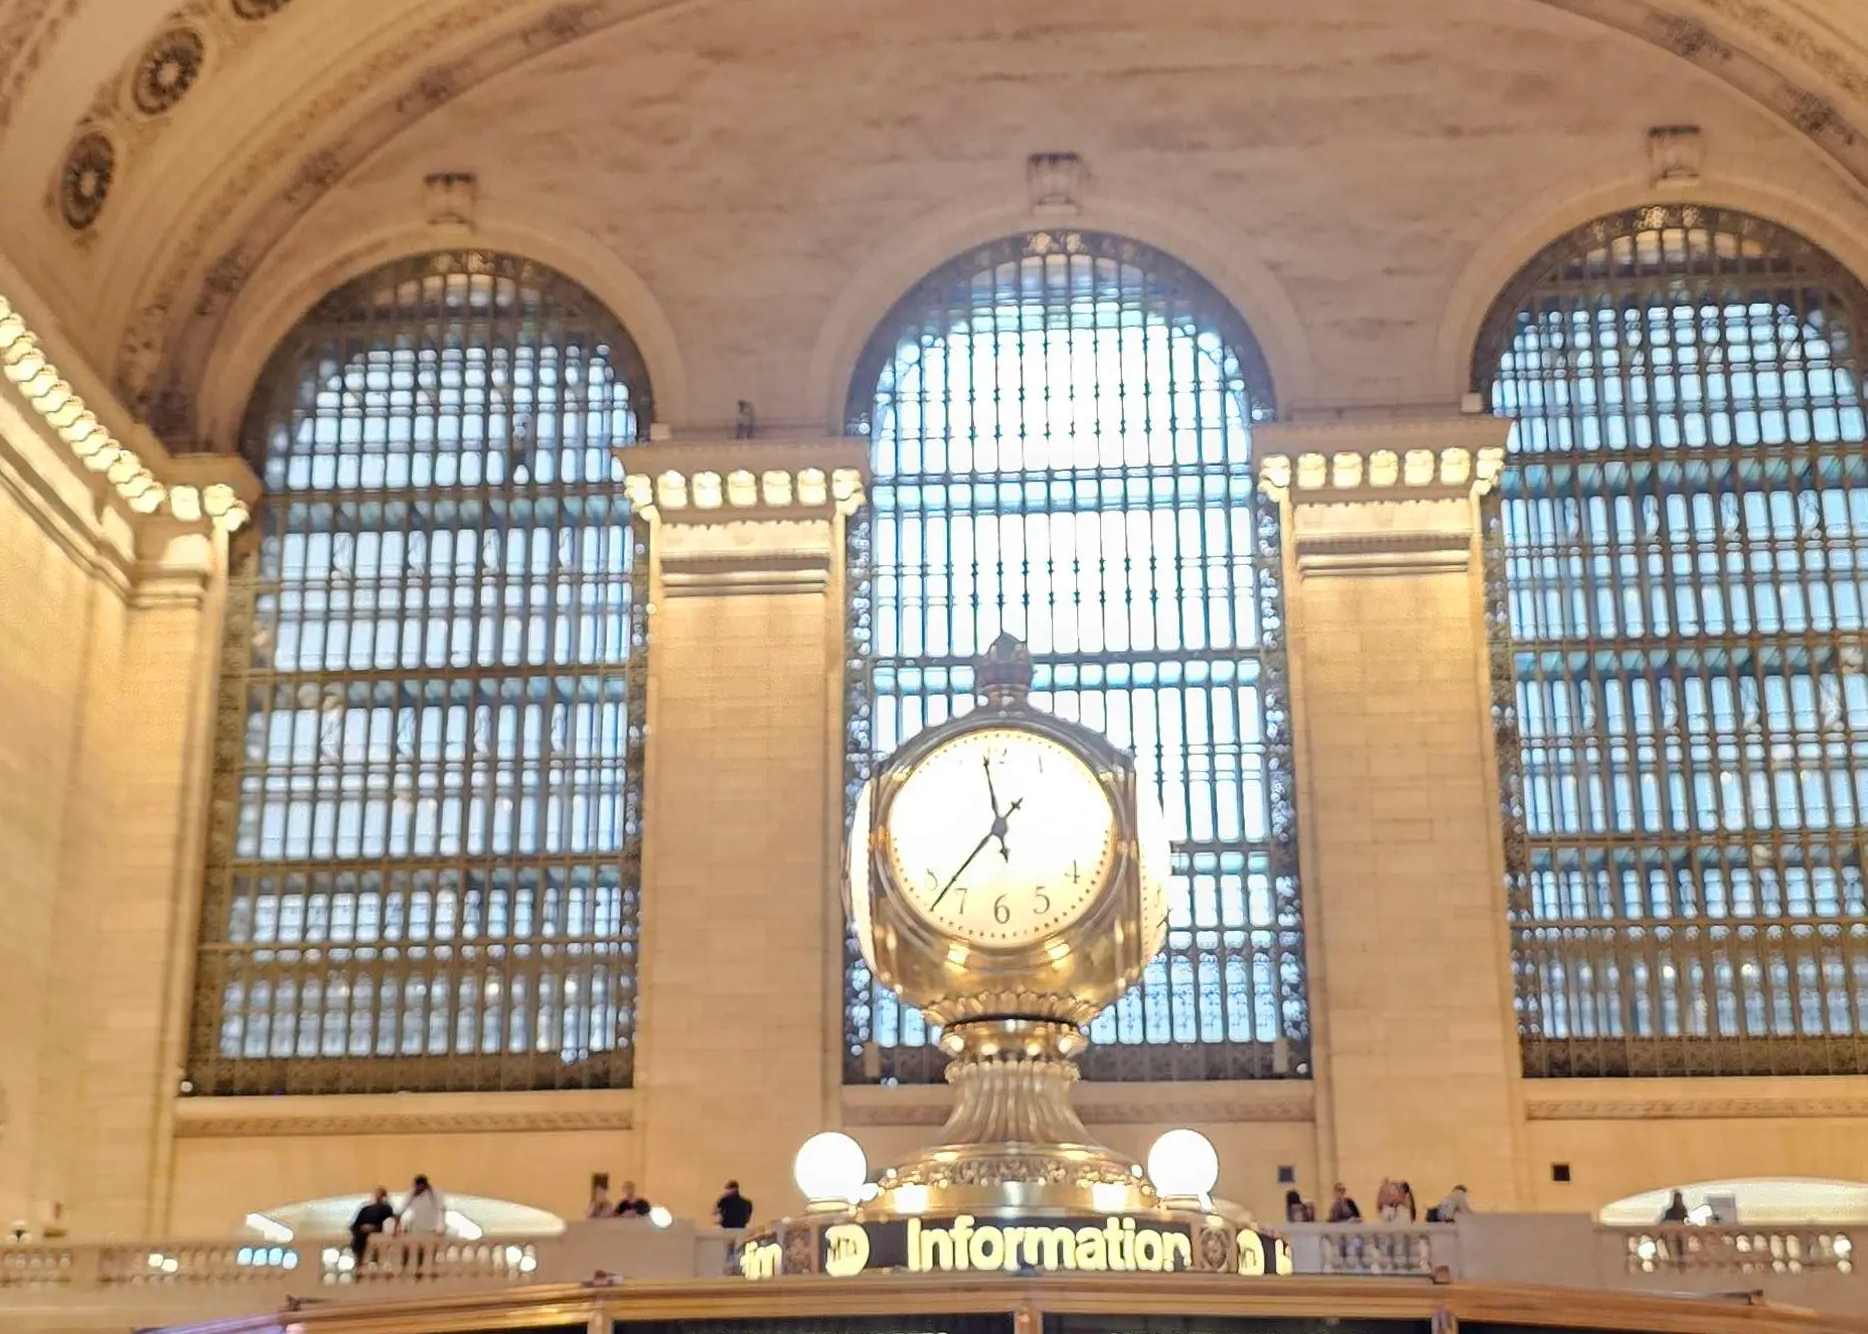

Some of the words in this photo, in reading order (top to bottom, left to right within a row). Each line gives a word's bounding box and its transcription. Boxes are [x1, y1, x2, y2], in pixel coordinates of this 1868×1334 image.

[1063, 858, 1082, 884] 4
[954, 887, 969, 915] 7
[993, 893, 1011, 925] 6
[1032, 886, 1051, 915] 5
[907, 1214, 1193, 1272] Information
